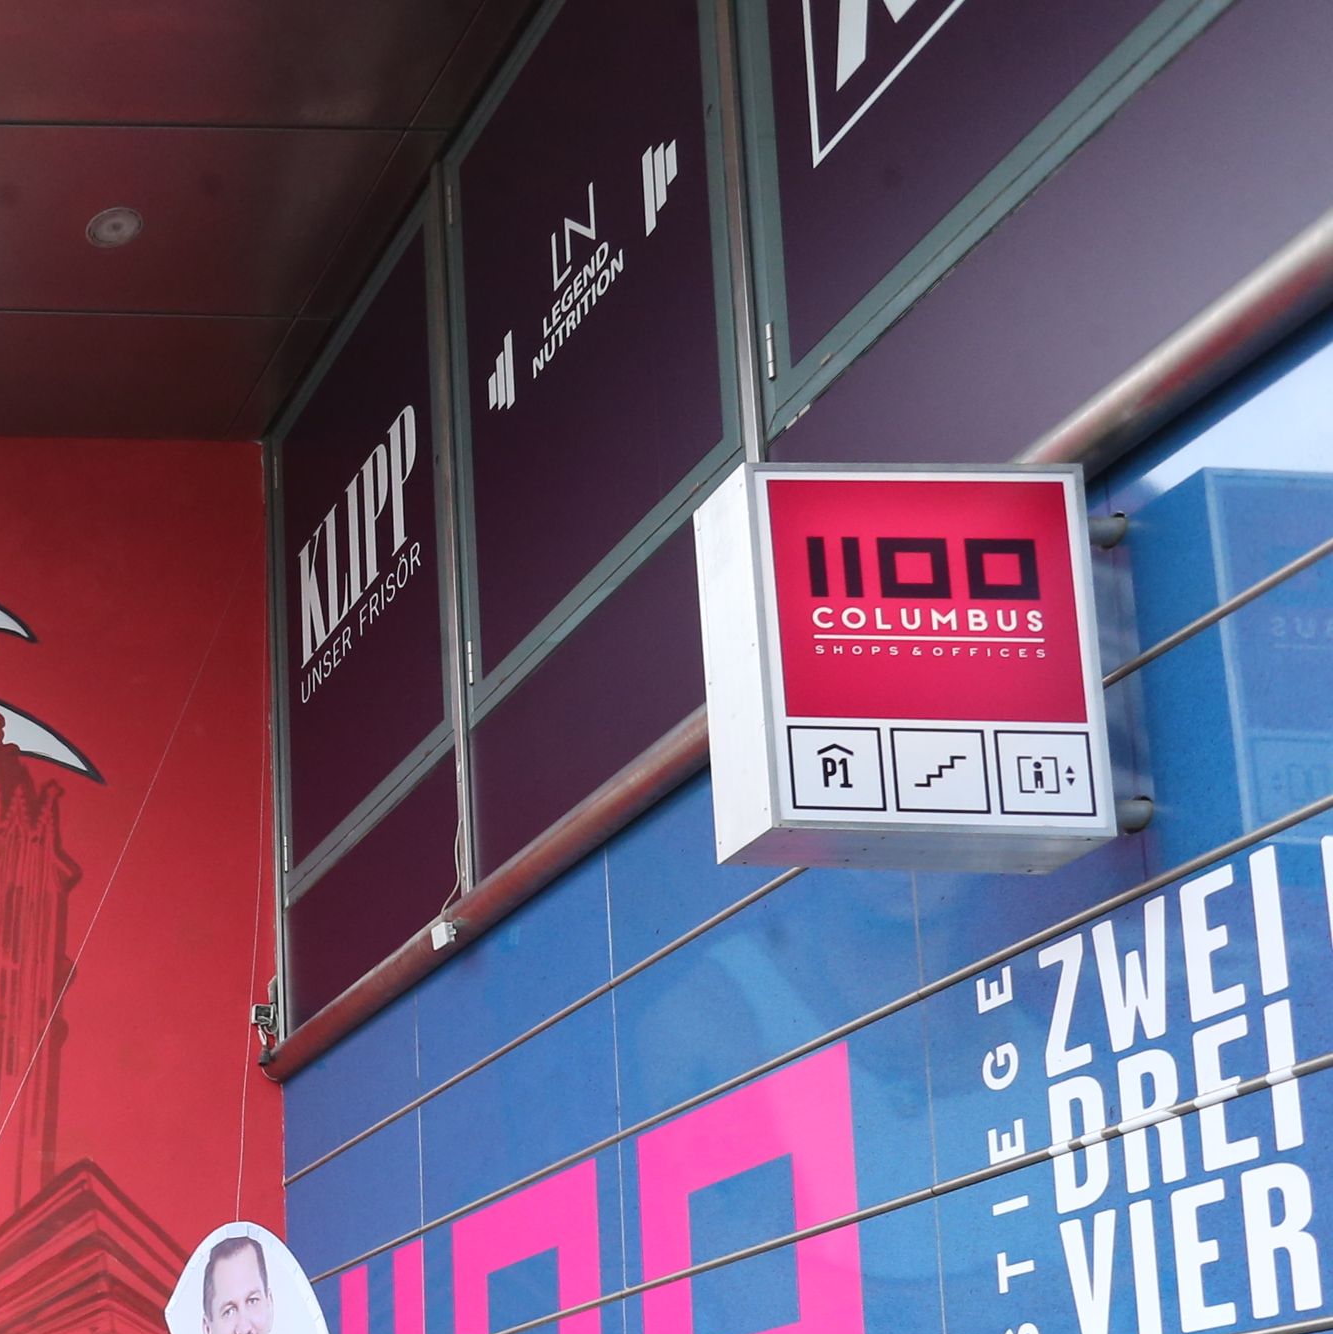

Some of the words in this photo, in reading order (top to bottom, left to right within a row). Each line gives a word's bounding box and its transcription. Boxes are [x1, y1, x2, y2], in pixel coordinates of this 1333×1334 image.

[533, 248, 624, 379] NUTRITION
[543, 241, 609, 338] LEGEND
[298, 405, 416, 668] KLIPP
[301, 626, 352, 703] UNSER
[359, 542, 421, 636] FRISÖR
[812, 606, 1044, 632] COLUMBUS
[815, 645, 899, 656] SHOPS
[912, 646, 923, 656] &
[933, 646, 1045, 658] OFFICES
[822, 757, 853, 788] P1
[1038, 845, 1289, 1078] ZWEI
[1048, 999, 1304, 1214] DREI
